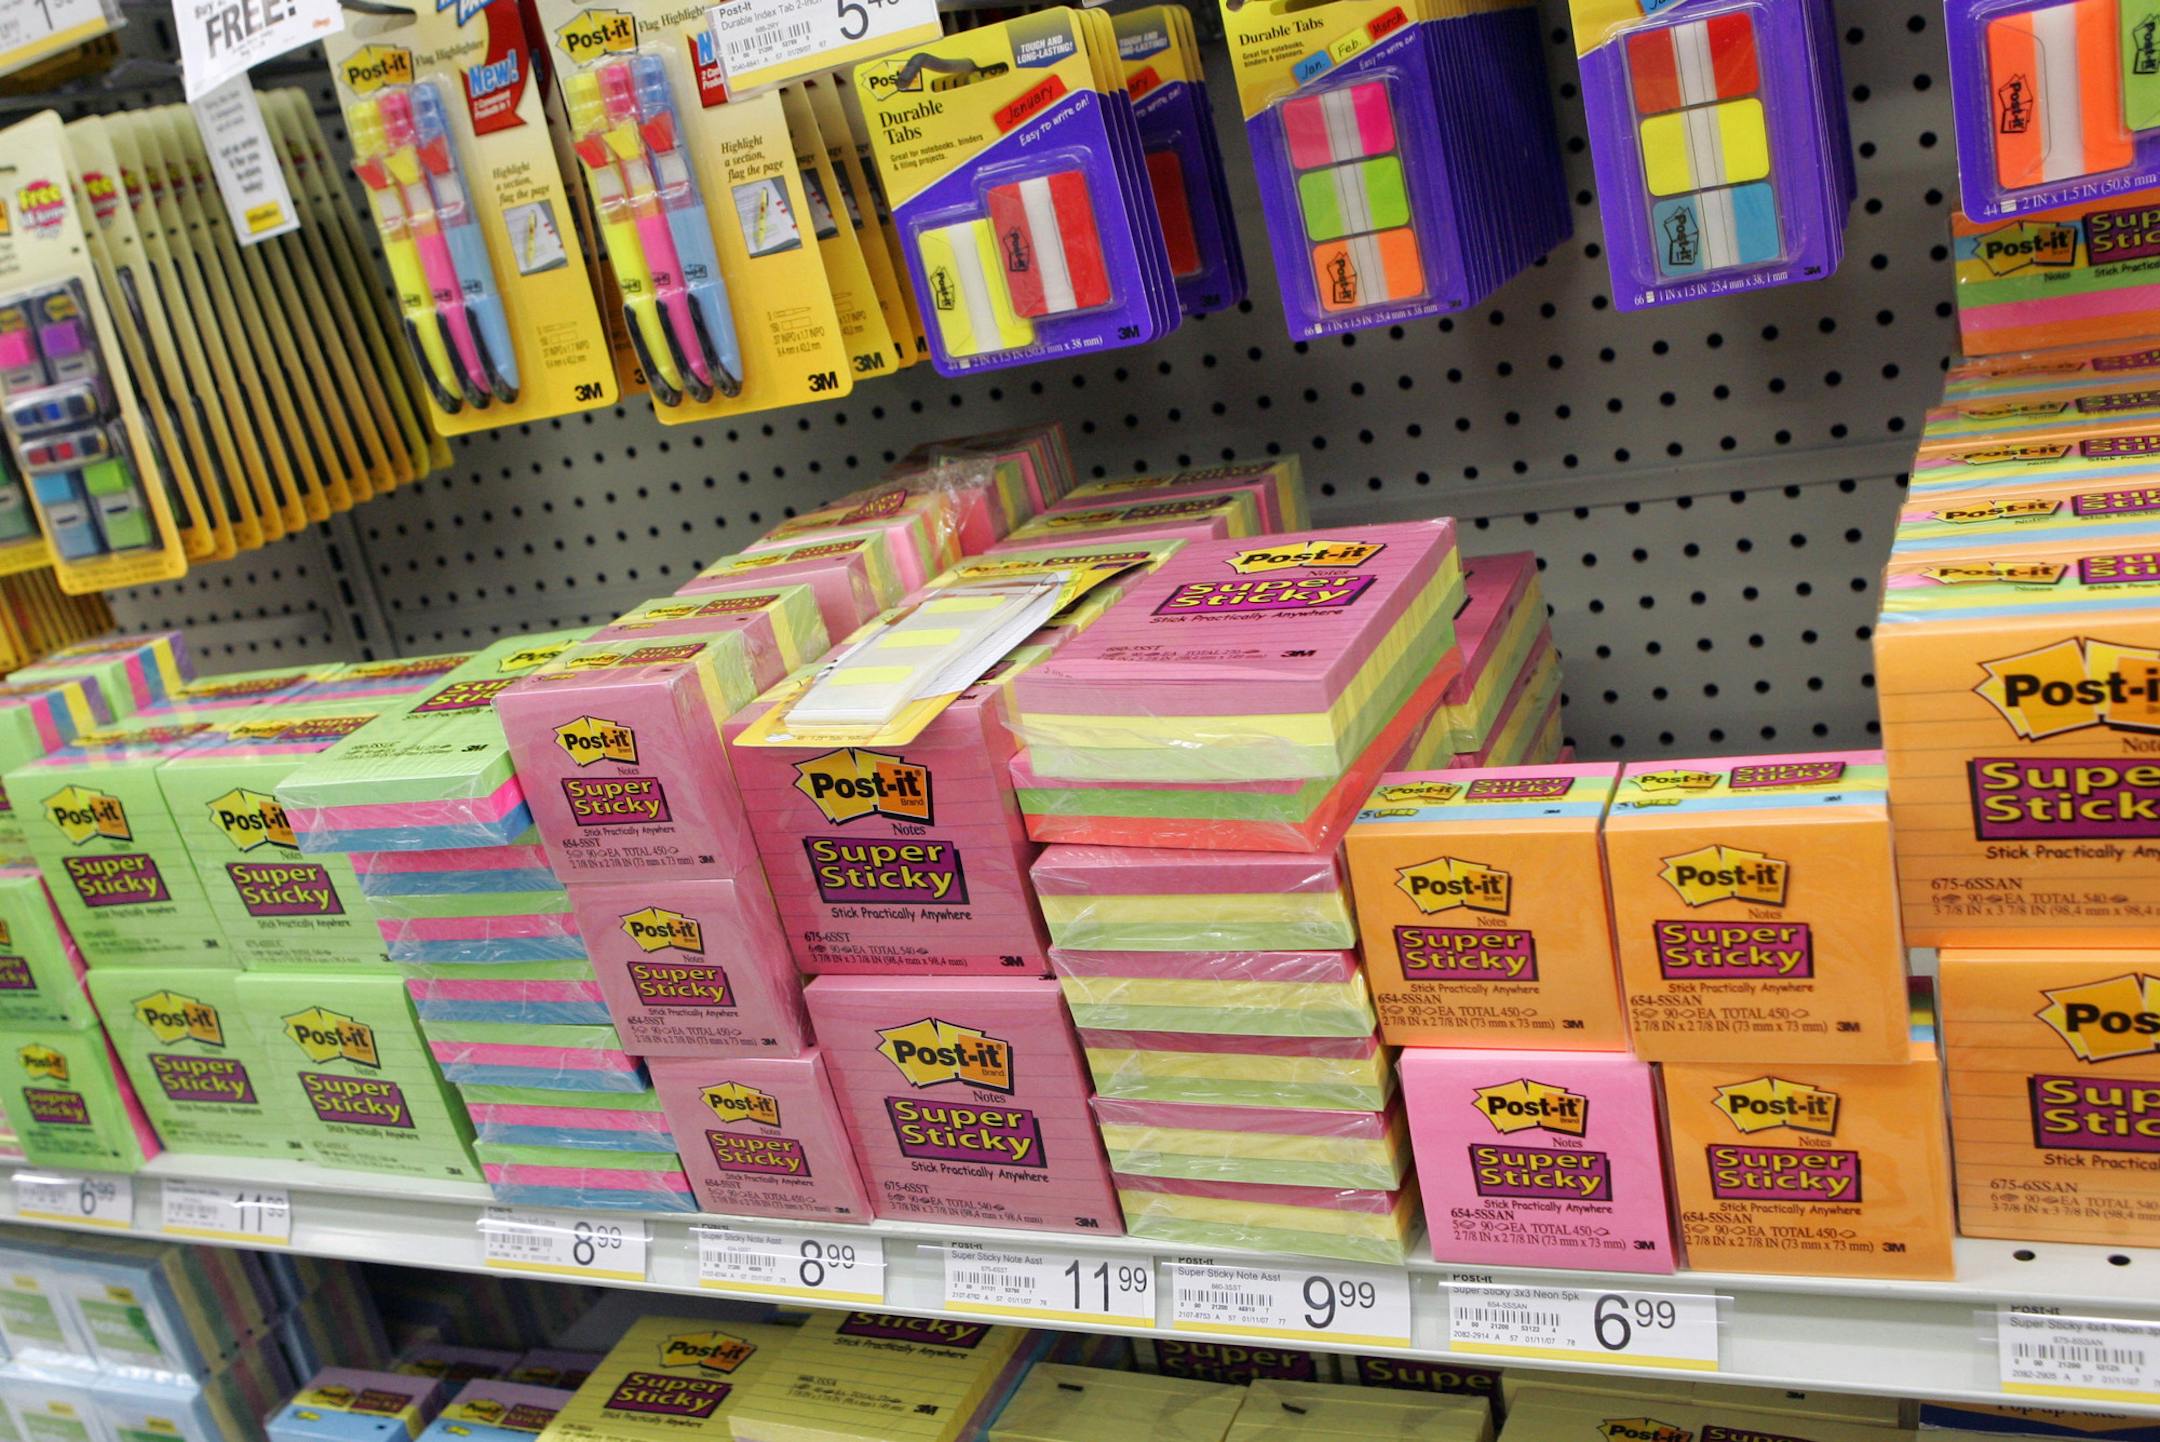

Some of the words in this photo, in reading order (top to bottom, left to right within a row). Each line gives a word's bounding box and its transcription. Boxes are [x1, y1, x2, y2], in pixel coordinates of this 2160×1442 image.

[721, 12, 753, 31] Durable
[754, 7, 777, 22] Index
[779, 4, 796, 15] Tab
[837, 0, 869, 40] 5
[566, 20, 631, 52] Post-it
[1239, 25, 1291, 46] Durable
[1295, 17, 1324, 33] Tabs
[1017, 42, 1073, 64] LONG-LASTING!
[1020, 40, 1046, 53] TOUGH
[1047, 35, 1063, 49] AND
[348, 55, 407, 84] Post-it
[469, 50, 519, 97] New!
[879, 100, 944, 128] Durable
[2007, 81, 2026, 129] Post-it
[883, 125, 923, 145] Tabs
[1018, 128, 1040, 146] Easy
[1986, 231, 2069, 260] Post-it
[1634, 295, 1645, 305] 66
[1664, 289, 1676, 301] IN
[1685, 286, 1696, 297] 1.5
[1698, 284, 1708, 296] IN
[1118, 326, 1139, 340] 3M
[853, 352, 885, 373] 3M
[808, 371, 839, 393] 3M
[575, 384, 603, 402] 3M
[1963, 445, 2059, 460] Post-it
[1945, 501, 2049, 520] Post-it
[1241, 546, 1368, 565] Post-it
[1939, 565, 2055, 577] Post-it
[1183, 577, 1360, 597] Super
[1170, 591, 1352, 609] Sticky
[1281, 649, 1317, 658] 3M
[564, 729, 630, 751] Post-it
[566, 781, 652, 800] Super
[810, 770, 922, 799] Post-it
[53, 801, 118, 827] Post-it
[574, 797, 660, 818] Sticky
[892, 823, 926, 836] Notes
[699, 855, 715, 864] 3M
[813, 840, 945, 867] Super
[67, 857, 146, 876] Super
[232, 866, 317, 885] Super
[1676, 863, 1777, 887] Post-it
[77, 872, 157, 898] Sticky
[820, 866, 953, 899] Sticky
[1410, 875, 1502, 896] Post-it
[1931, 877, 2023, 890] 675-6SSAN
[242, 886, 330, 910] Sticky
[831, 907, 859, 919] Stick
[861, 907, 916, 923] Practically
[920, 908, 973, 921] Anywhere
[630, 921, 696, 938] Post-it
[804, 930, 850, 943] 675-6SST
[1662, 923, 1800, 948] Super
[1401, 930, 1524, 952] Super
[999, 956, 1025, 967] 3M
[1406, 950, 1528, 977] Sticky
[1664, 946, 1802, 973] Sticky
[633, 964, 717, 982] Super
[639, 982, 725, 1004] Sticky
[1378, 994, 1442, 1005] 654-5SSAN
[144, 1007, 212, 1030] Post-it
[1562, 1020, 1584, 1029] 3M
[296, 1023, 369, 1049] Post-it
[893, 1039, 1001, 1068] Post-it
[153, 1056, 237, 1078] Super
[162, 1071, 247, 1100] Sticky
[304, 1074, 393, 1097] Super
[315, 1093, 402, 1123] Sticky
[710, 1093, 772, 1112] Post-it
[1487, 1095, 1578, 1117] Post-it
[1729, 1094, 1829, 1116] Post-it
[893, 1100, 1024, 1130] Super
[711, 1133, 793, 1152] Super
[900, 1124, 1032, 1161] Sticky
[1552, 1137, 1583, 1149] Notes
[718, 1149, 801, 1173] Sticky
[1478, 1148, 1599, 1171] Super
[1715, 1148, 1848, 1173] Super
[884, 1181, 929, 1194] 675-6SST
[1479, 1168, 1602, 1196] Sticky
[1717, 1170, 1851, 1198] Sticky
[1451, 1208, 1515, 1221] 654-5SSAN
[1484, 1199, 1509, 1210] Stick
[1511, 1200, 1562, 1214] Practically
[1565, 1203, 1613, 1215] Anywhere
[1633, 1241, 1655, 1250] 3M
[952, 1250, 976, 1260] Super
[976, 1252, 1001, 1264] Sticky
[1002, 1254, 1023, 1264] Note
[1178, 1268, 1205, 1278] Super
[1206, 1268, 1234, 1281] Sticky
[1235, 1271, 1259, 1281] Note
[1513, 1289, 1531, 1298] 3x3
[1533, 1290, 1559, 1300] Neon
[1562, 1291, 1580, 1301] 5pk
[2010, 1317, 2044, 1329] Super
[2048, 1320, 2082, 1333] Sticky
[666, 1341, 745, 1361] Post-it
[626, 1372, 723, 1394] Super
[613, 1387, 713, 1411] Sticky
[912, 1402, 939, 1416] 3M
